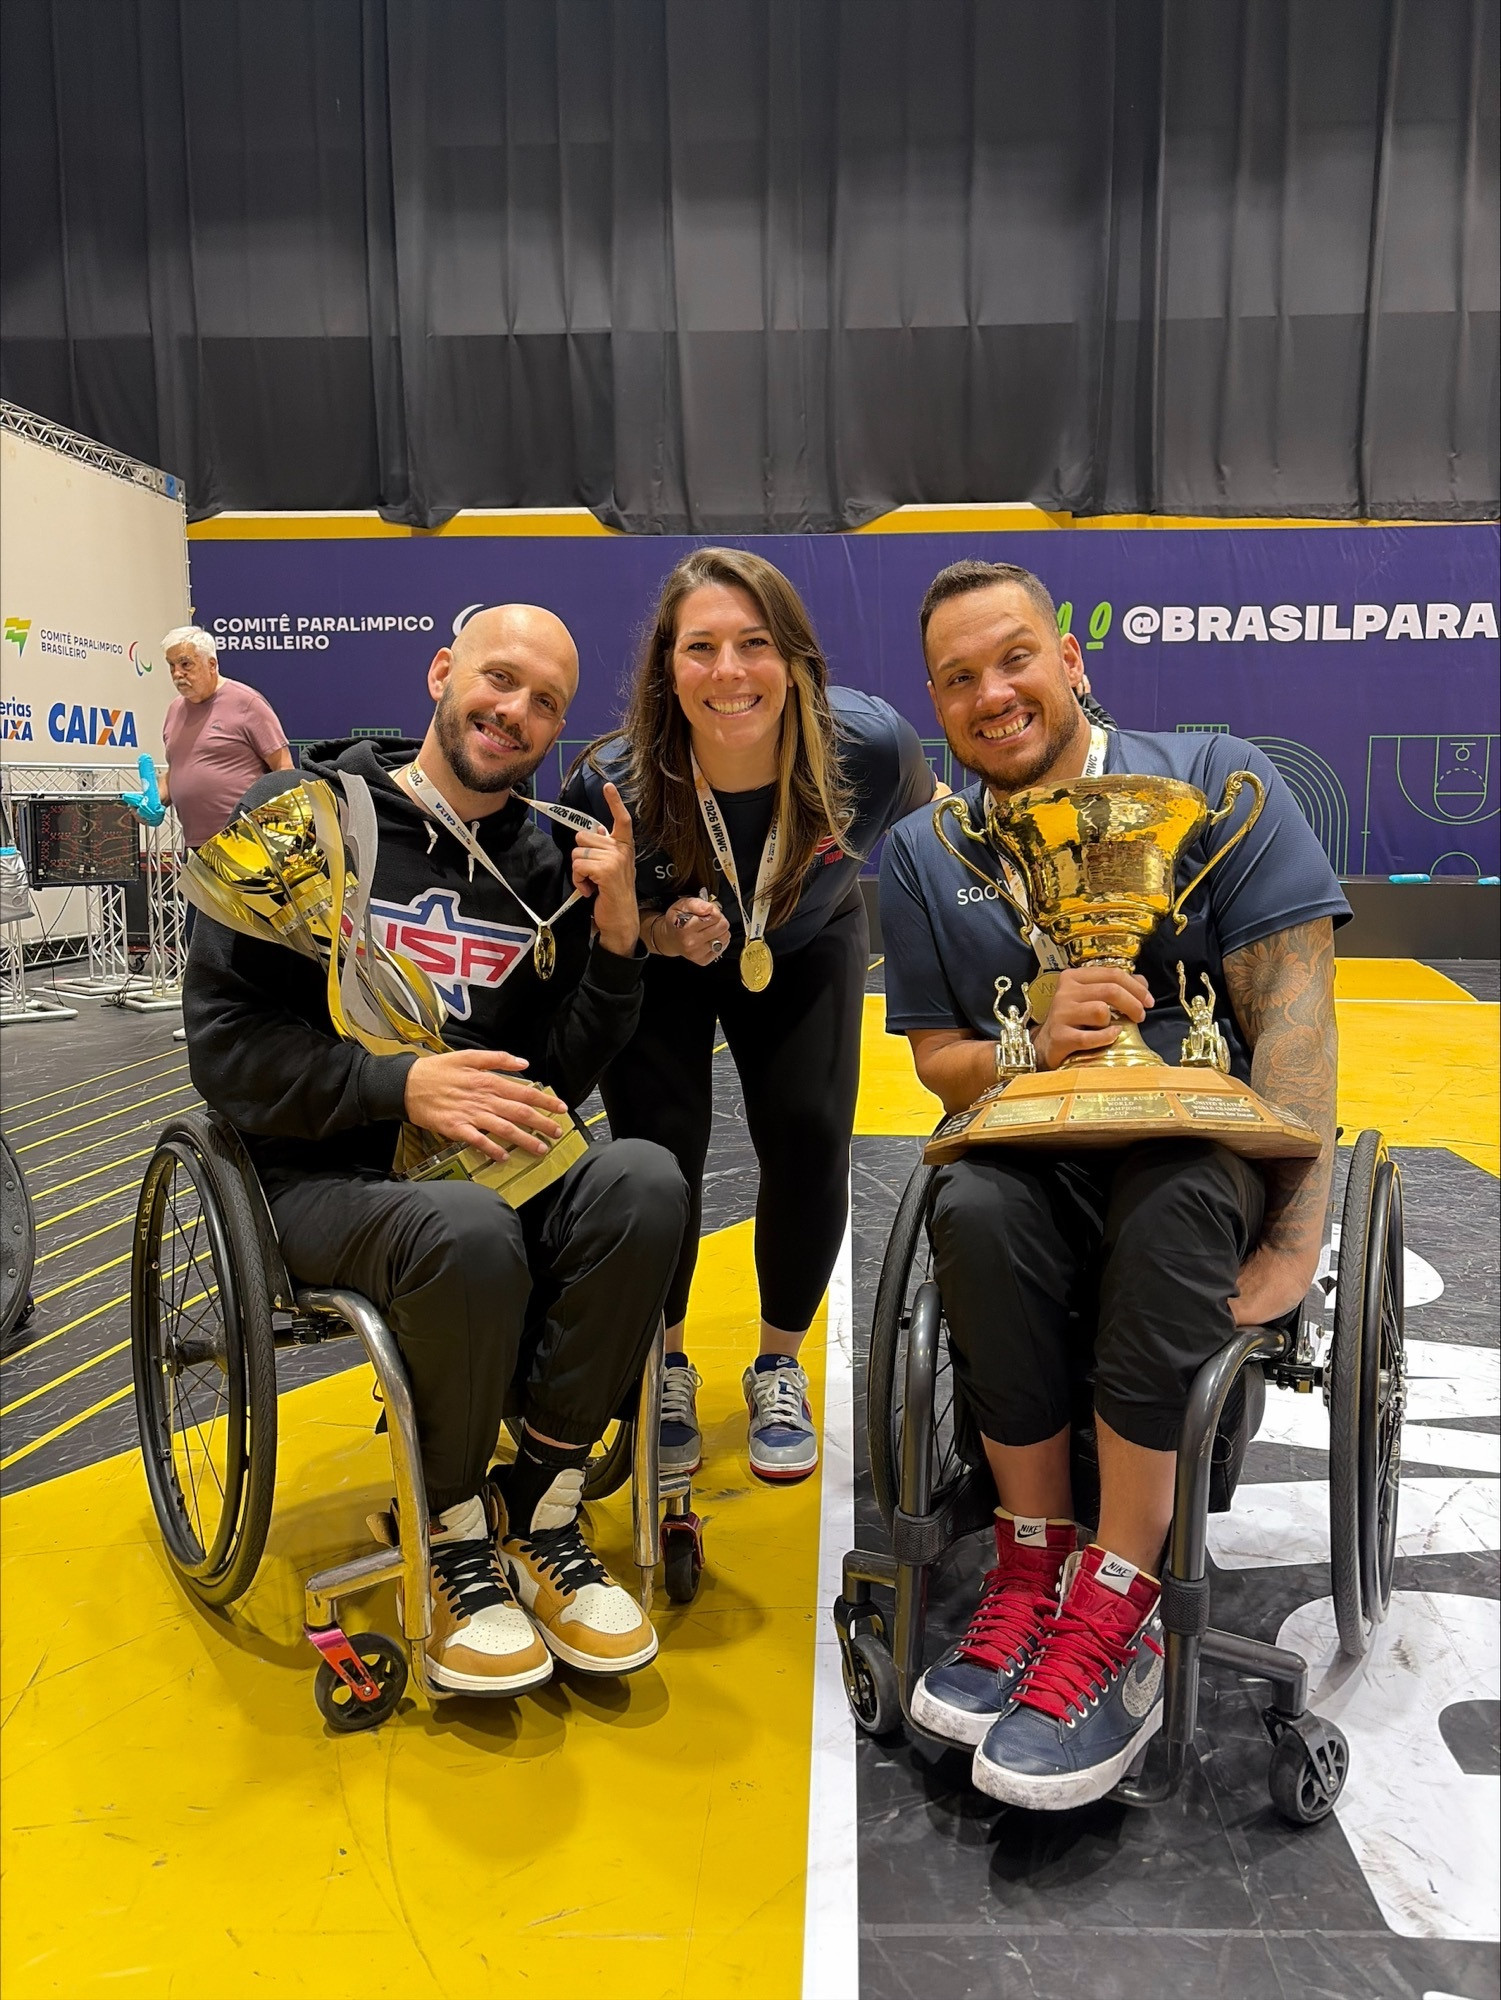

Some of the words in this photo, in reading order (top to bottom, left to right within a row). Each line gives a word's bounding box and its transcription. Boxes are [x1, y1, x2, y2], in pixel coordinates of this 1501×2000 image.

[213, 614, 291, 633] COMITÊ
[1122, 602, 1499, 644] @BRASILPARA
[41, 642, 87, 659] BRASILEIRO
[215, 635, 330, 650] BRASILEIRO
[0, 719, 33, 741] IXA
[48, 702, 138, 748] CAIXA
[549, 805, 568, 818] 2026
[568, 811, 593, 830] WRWC
[704, 800, 719, 822] 2026
[711, 822, 728, 852] WRWC
[1020, 1523, 1041, 1535] NIKE
[1109, 1561, 1130, 1577] NIKE
